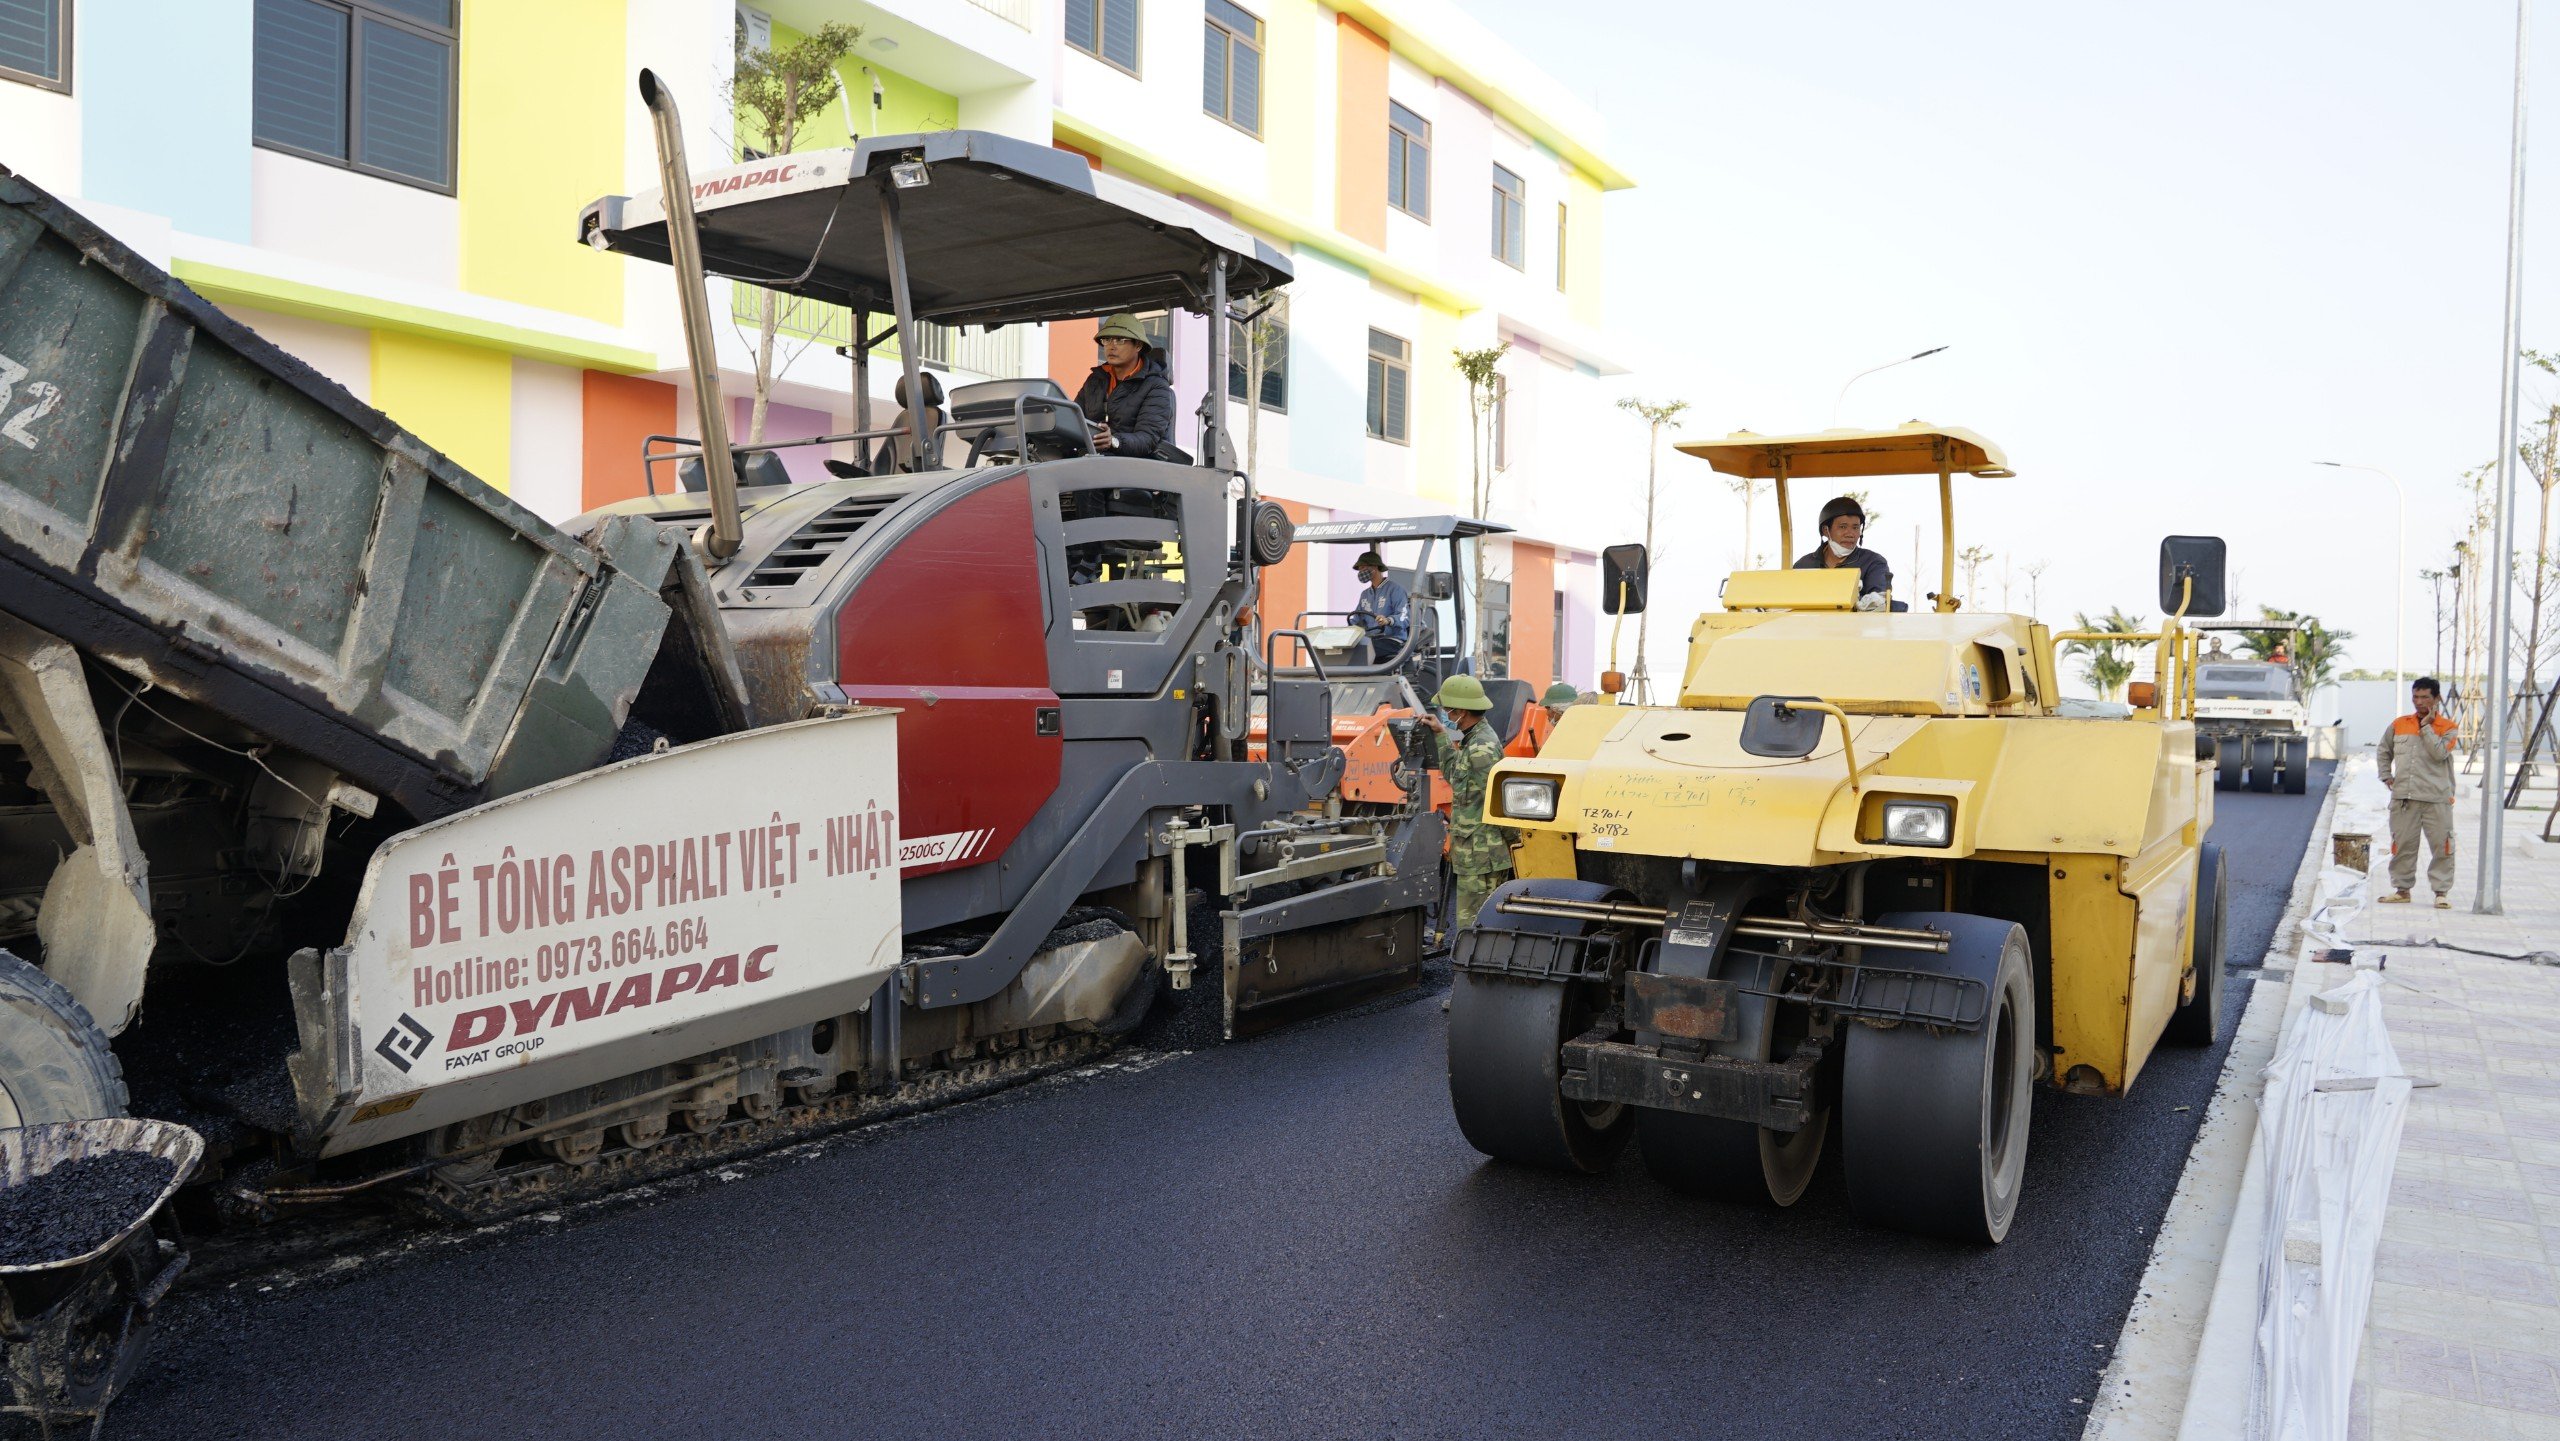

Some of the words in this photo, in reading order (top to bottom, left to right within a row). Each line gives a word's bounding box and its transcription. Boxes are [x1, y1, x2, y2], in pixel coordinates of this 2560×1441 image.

[690, 165, 797, 199] YNAPAC
[1311, 524, 1347, 535] ASPHALT
[1590, 823, 1630, 836] 30782
[899, 841, 946, 861] 2500CS
[409, 852, 462, 950] BÊ
[473, 845, 575, 938] TÔNG
[585, 831, 731, 920] ASPHALT
[738, 811, 801, 899] VIỆT
[808, 848, 819, 862] -
[826, 798, 895, 881] NHẬT
[412, 955, 529, 1008] Hotline:
[536, 915, 709, 984] 0973.664.664
[445, 943, 779, 1053] DYNAPAC
[445, 1049, 490, 1071] FAYAT
[495, 1036, 545, 1059] GROUP
